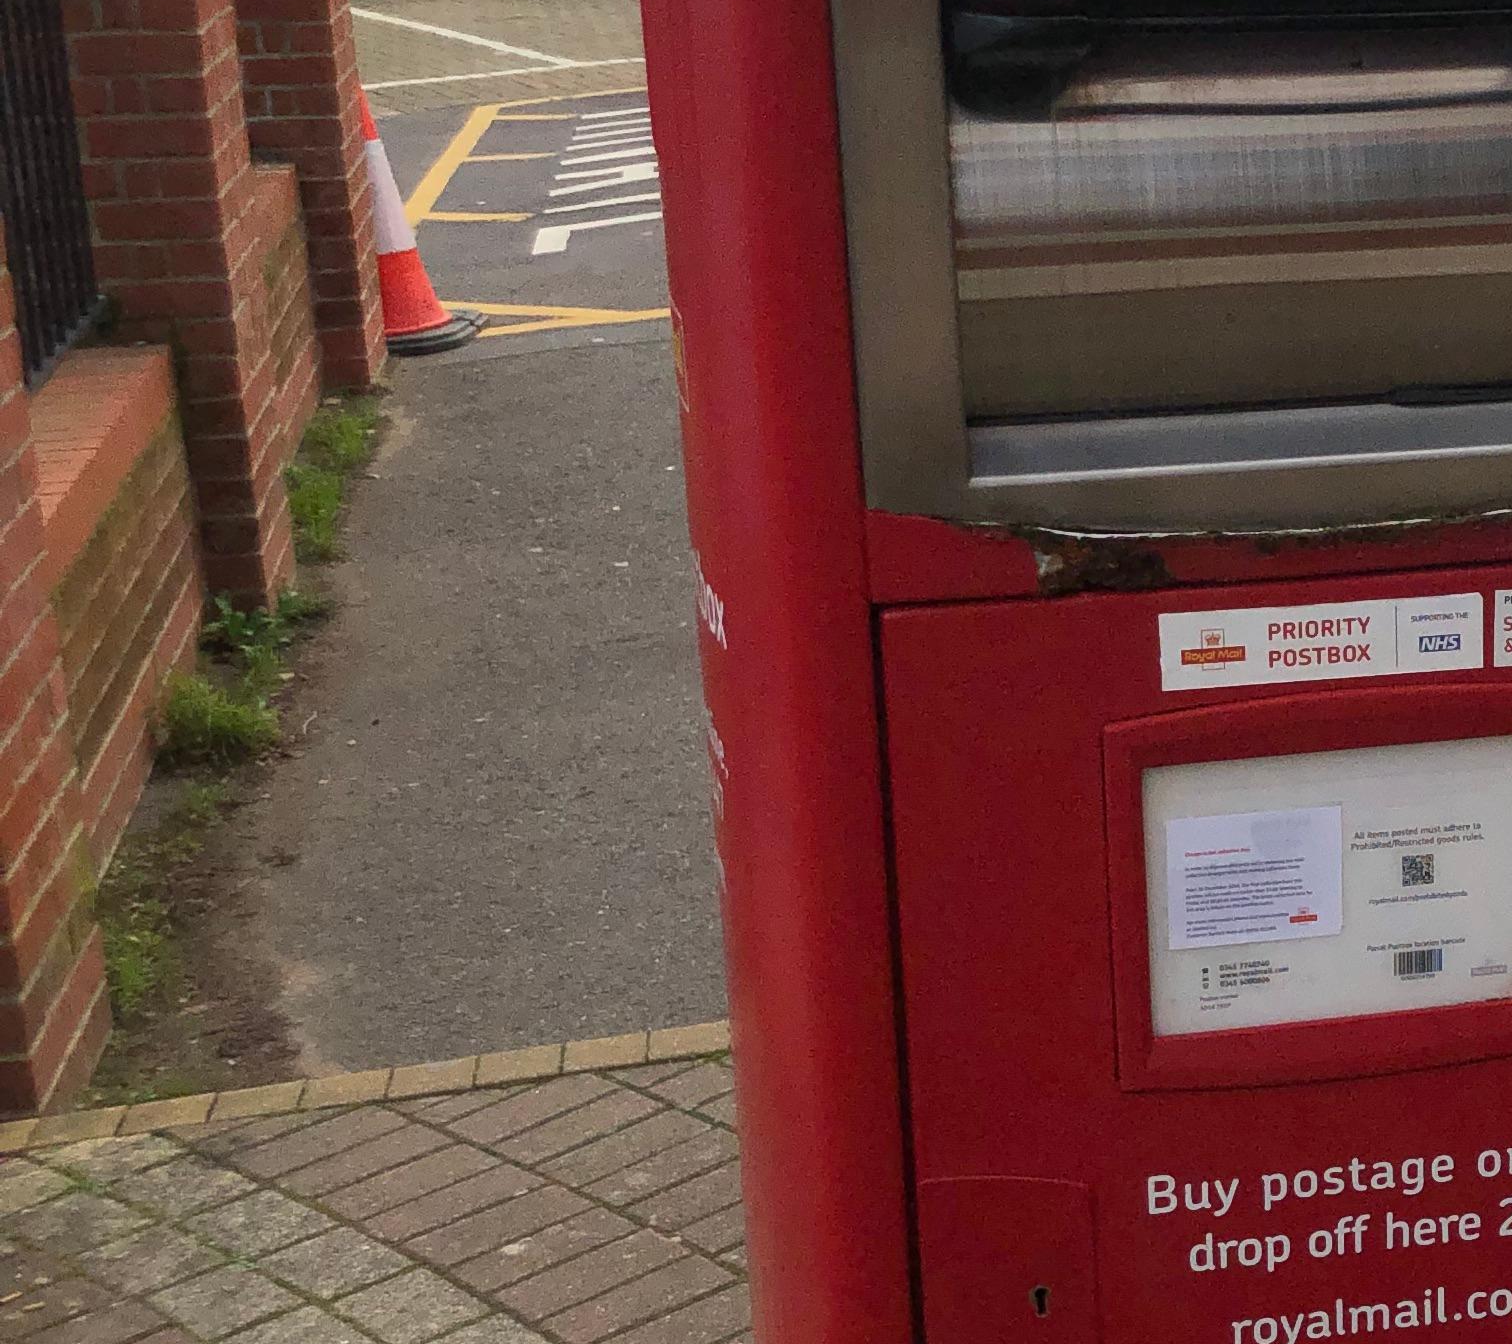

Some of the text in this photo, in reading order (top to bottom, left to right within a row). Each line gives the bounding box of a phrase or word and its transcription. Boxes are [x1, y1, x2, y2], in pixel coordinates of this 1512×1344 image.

[1410, 611, 1469, 623] SUPPORTING THE
[1267, 616, 1372, 641] PRIORITY
[1421, 635, 1459, 652] NHS
[1184, 648, 1243, 663] Royal Mail
[1267, 644, 1372, 669] POSTBOX
[1354, 822, 1482, 840] All items posted must adhere to
[1350, 836, 1435, 851] Prohibited/Restricted
[1436, 835, 1461, 845] goods
[1147, 1174, 1240, 1216] Buy
[1262, 1154, 1455, 1211] postage
[1188, 1233, 1290, 1273] drop
[1308, 1214, 1371, 1259] off
[1386, 1211, 1481, 1250] here
